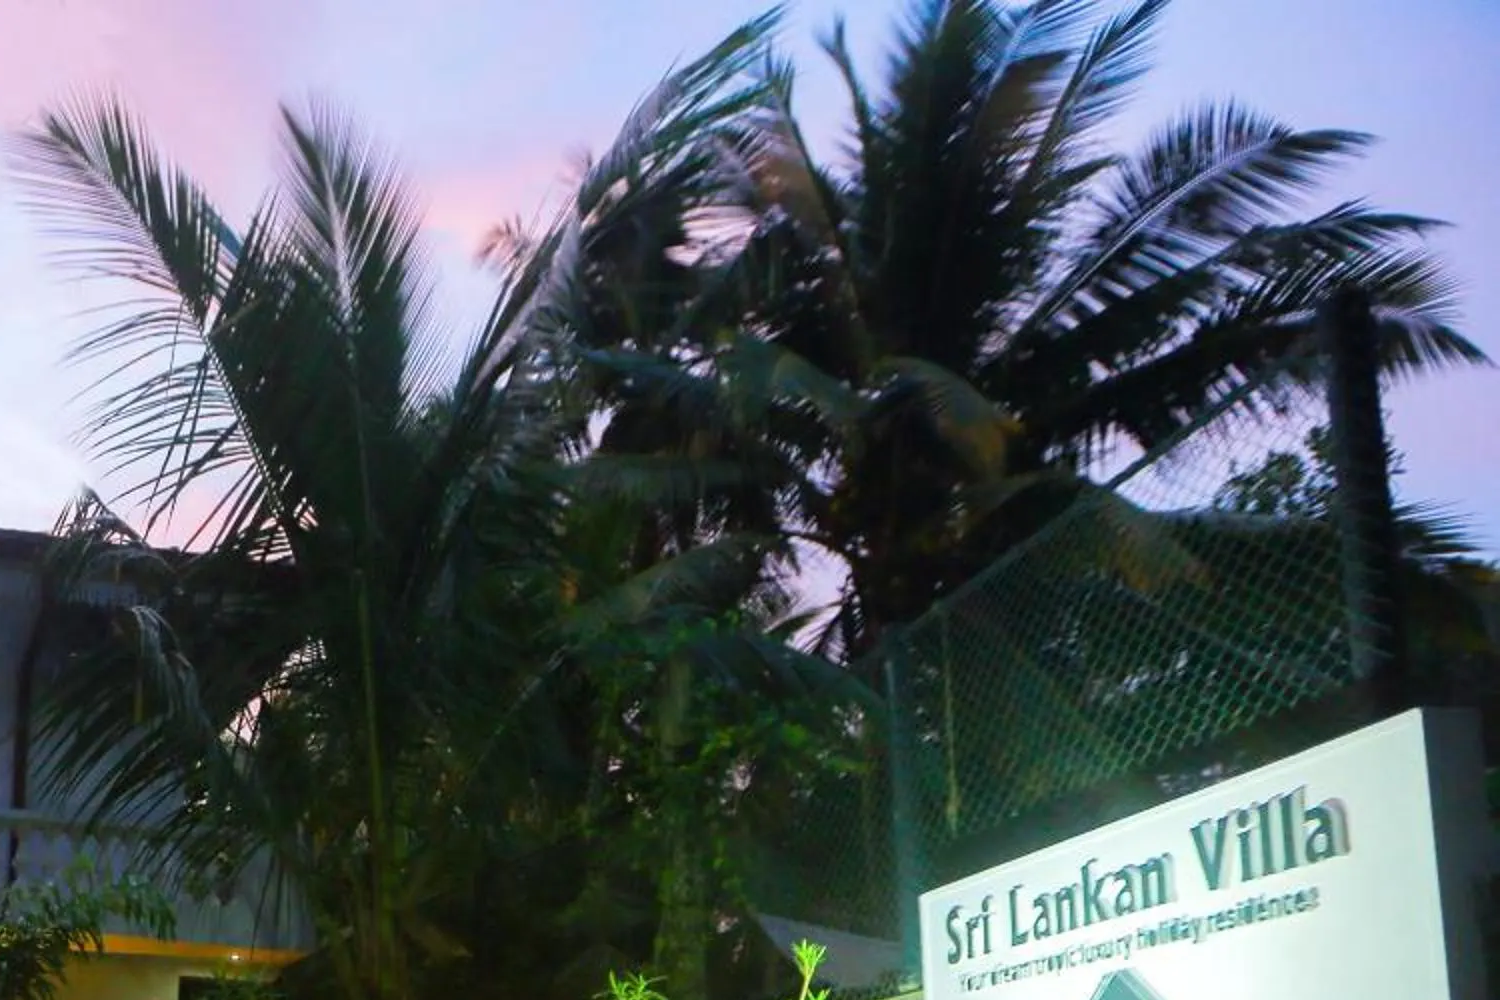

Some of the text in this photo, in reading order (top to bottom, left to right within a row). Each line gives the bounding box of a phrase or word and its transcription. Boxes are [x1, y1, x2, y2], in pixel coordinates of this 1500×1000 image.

[946, 784, 1350, 965] Sri Lankan Villa
